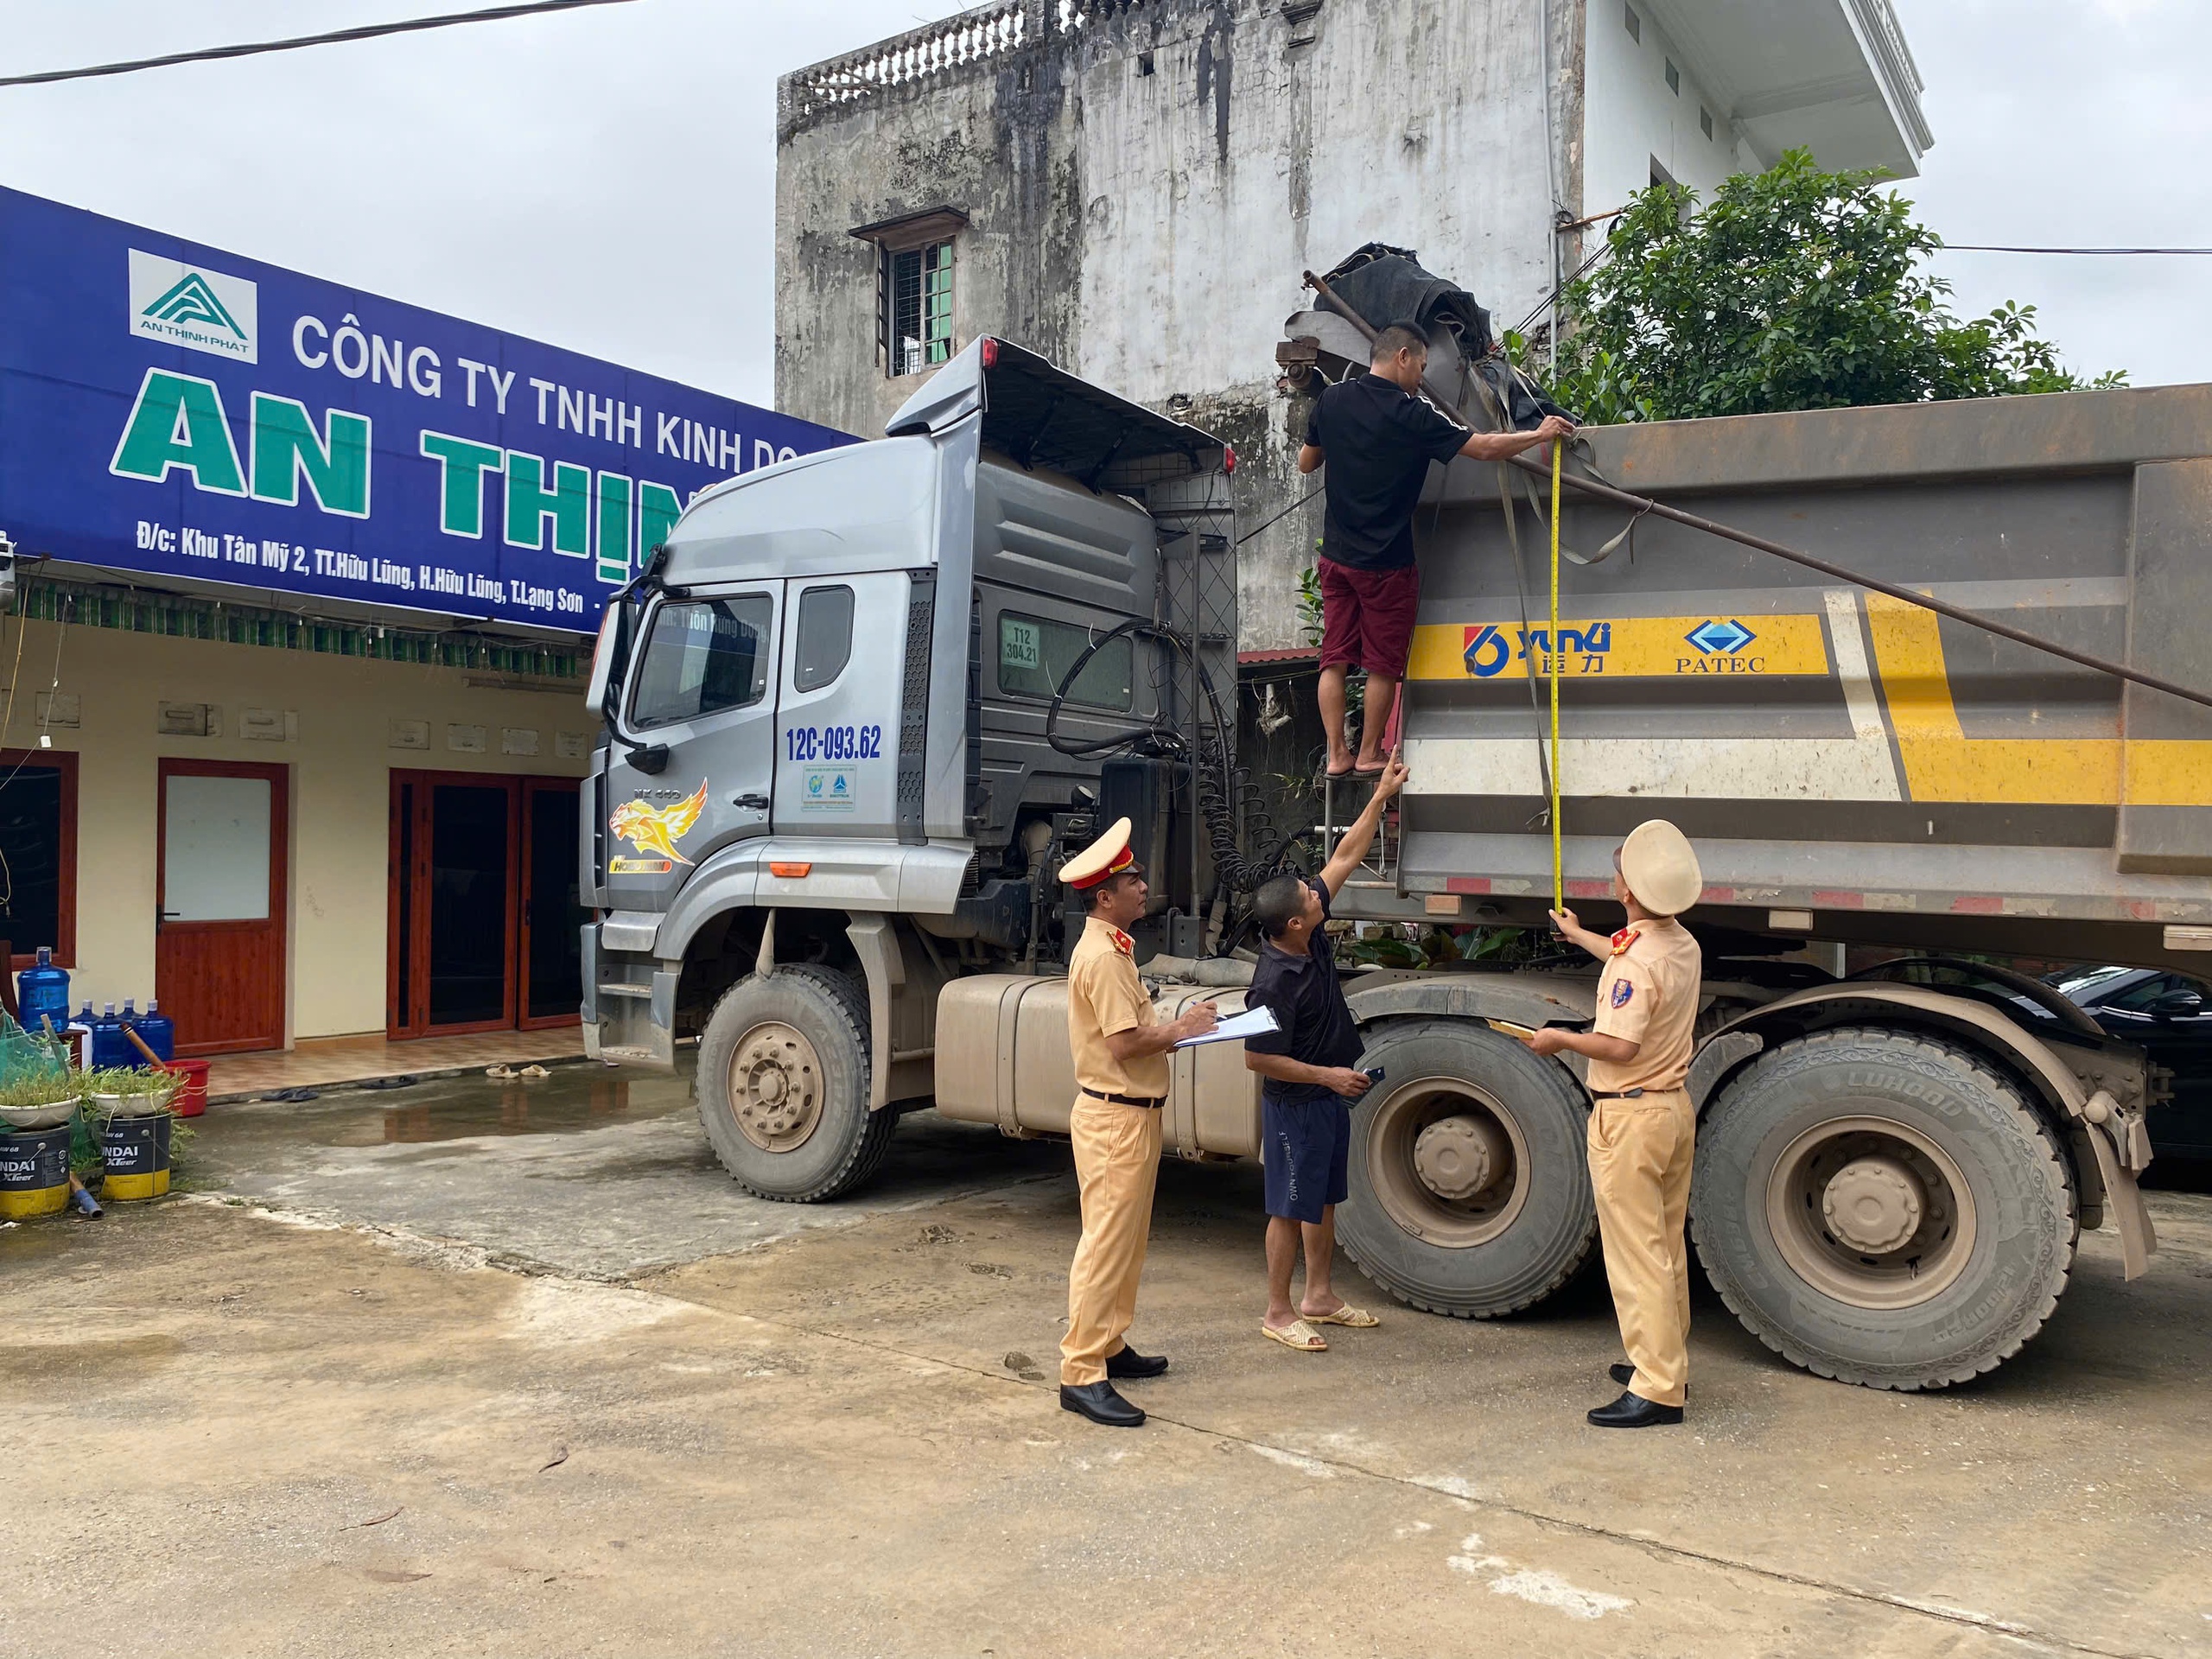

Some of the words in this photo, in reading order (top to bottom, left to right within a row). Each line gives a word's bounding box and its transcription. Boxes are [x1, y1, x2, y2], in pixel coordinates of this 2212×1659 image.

[140, 320, 162, 333] AN
[292, 313, 442, 398] CÔNG
[457, 357, 517, 415] TY
[529, 377, 642, 449] TNHH
[657, 411, 741, 474] KINH
[753, 438, 810, 471] DO
[109, 365, 372, 520] AN
[137, 520, 176, 551] Đ/c:
[181, 527, 219, 559] Khu
[223, 534, 257, 565] Tân
[261, 540, 289, 573] Mỹ
[293, 546, 310, 576] 2,
[315, 549, 368, 582] TT.Hữu
[372, 557, 416, 591] Lũng,
[419, 564, 464, 595] H.Hữu
[467, 572, 507, 605] Lũng,
[510, 580, 554, 611] T.Lạng
[557, 588, 583, 613] Sơn
[1014, 626, 1031, 645] T12
[1006, 643, 1037, 663] 304.21
[1675, 657, 1766, 673] PATEC
[786, 724, 882, 761] 12C-093.62
[1288, 1178, 1299, 1201] OWN
